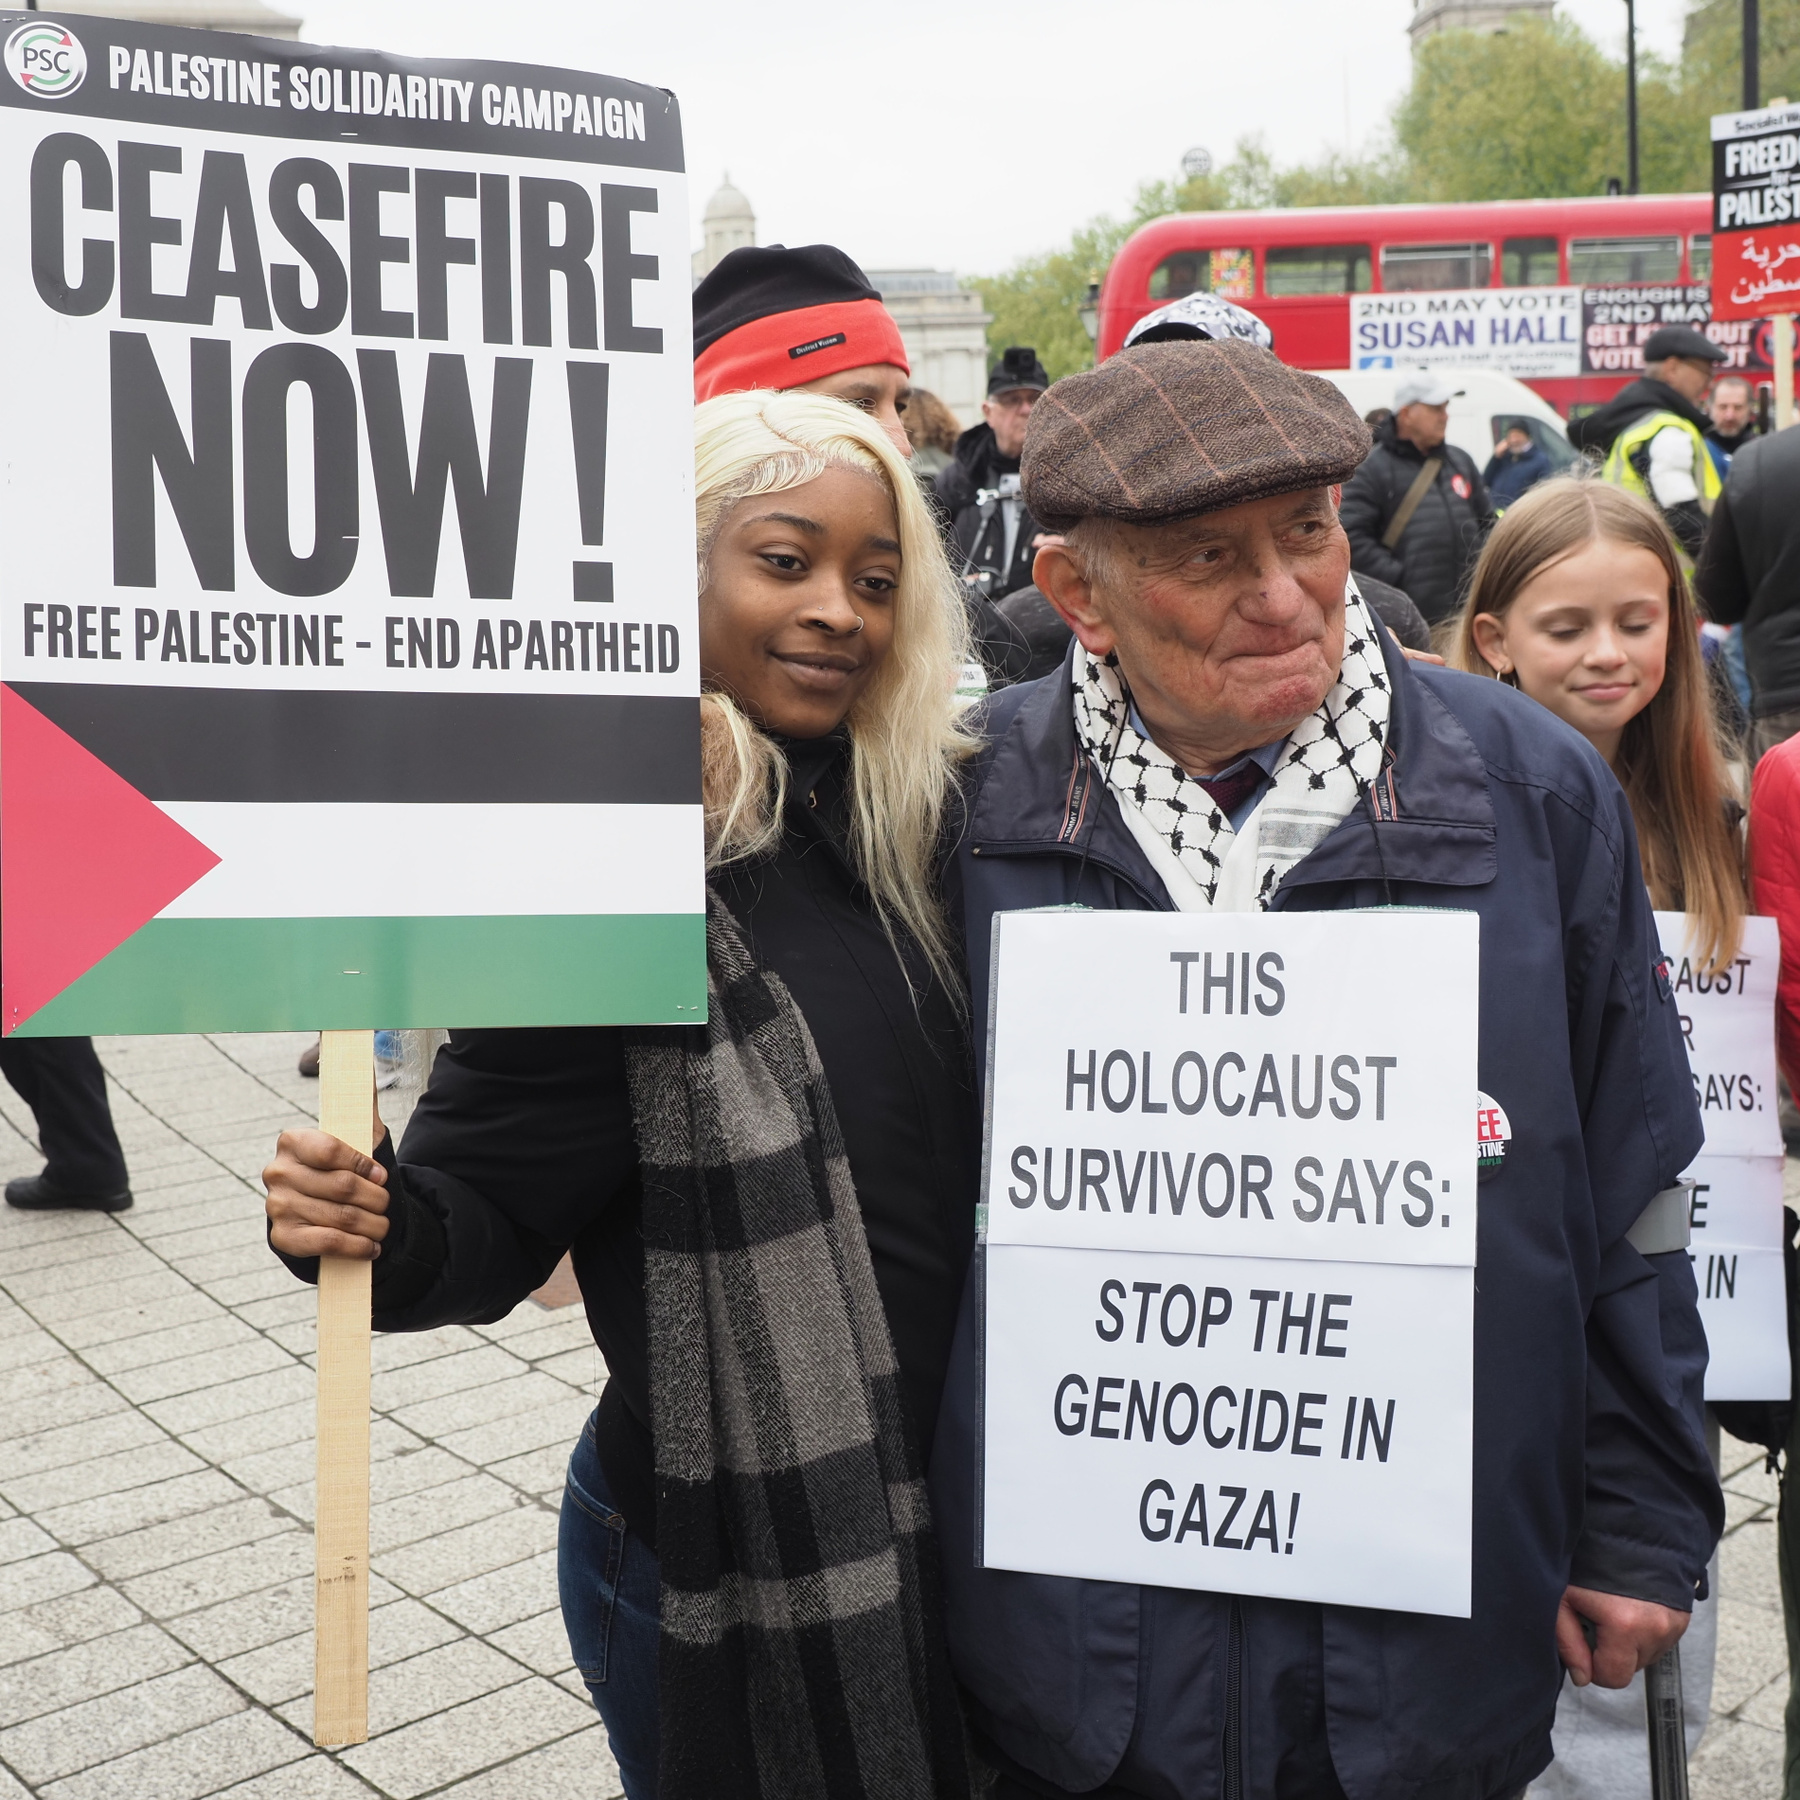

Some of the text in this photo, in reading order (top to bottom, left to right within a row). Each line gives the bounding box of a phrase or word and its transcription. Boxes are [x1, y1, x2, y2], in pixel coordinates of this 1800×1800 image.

[23, 46, 71, 75] PSC
[109, 45, 646, 142] PALESTINE SOLIDARITY CAMPAIGN
[1725, 134, 1800, 178] FREED
[29, 131, 665, 355] CEASEFIRE
[1360, 293, 1578, 317] 2ND MAY VOTE
[1583, 285, 1710, 304] ENOUGH IS
[1594, 303, 1656, 324] 2ND
[1359, 315, 1578, 350] SUSAN HALL
[1586, 323, 1633, 347] GET
[1705, 321, 1754, 346] OUT
[23, 602, 122, 660] FREE
[134, 607, 345, 667] PALESTINE
[385, 616, 461, 669] END
[472, 618, 680, 674] APARTHEID
[1063, 811, 1078, 838] TOMMY
[1072, 785, 1083, 809] JEANS
[1169, 951, 1286, 1017] THIS
[1065, 1048, 1398, 1121] HOLOCAUST
[1008, 1145, 1451, 1228] SURVIVOR SAYS:
[1705, 1254, 1738, 1299] IN
[1095, 1278, 1353, 1358] STOP THE
[1053, 1373, 1396, 1463] GENOCIDE IN
[1139, 1478, 1301, 1555] GAZA!
